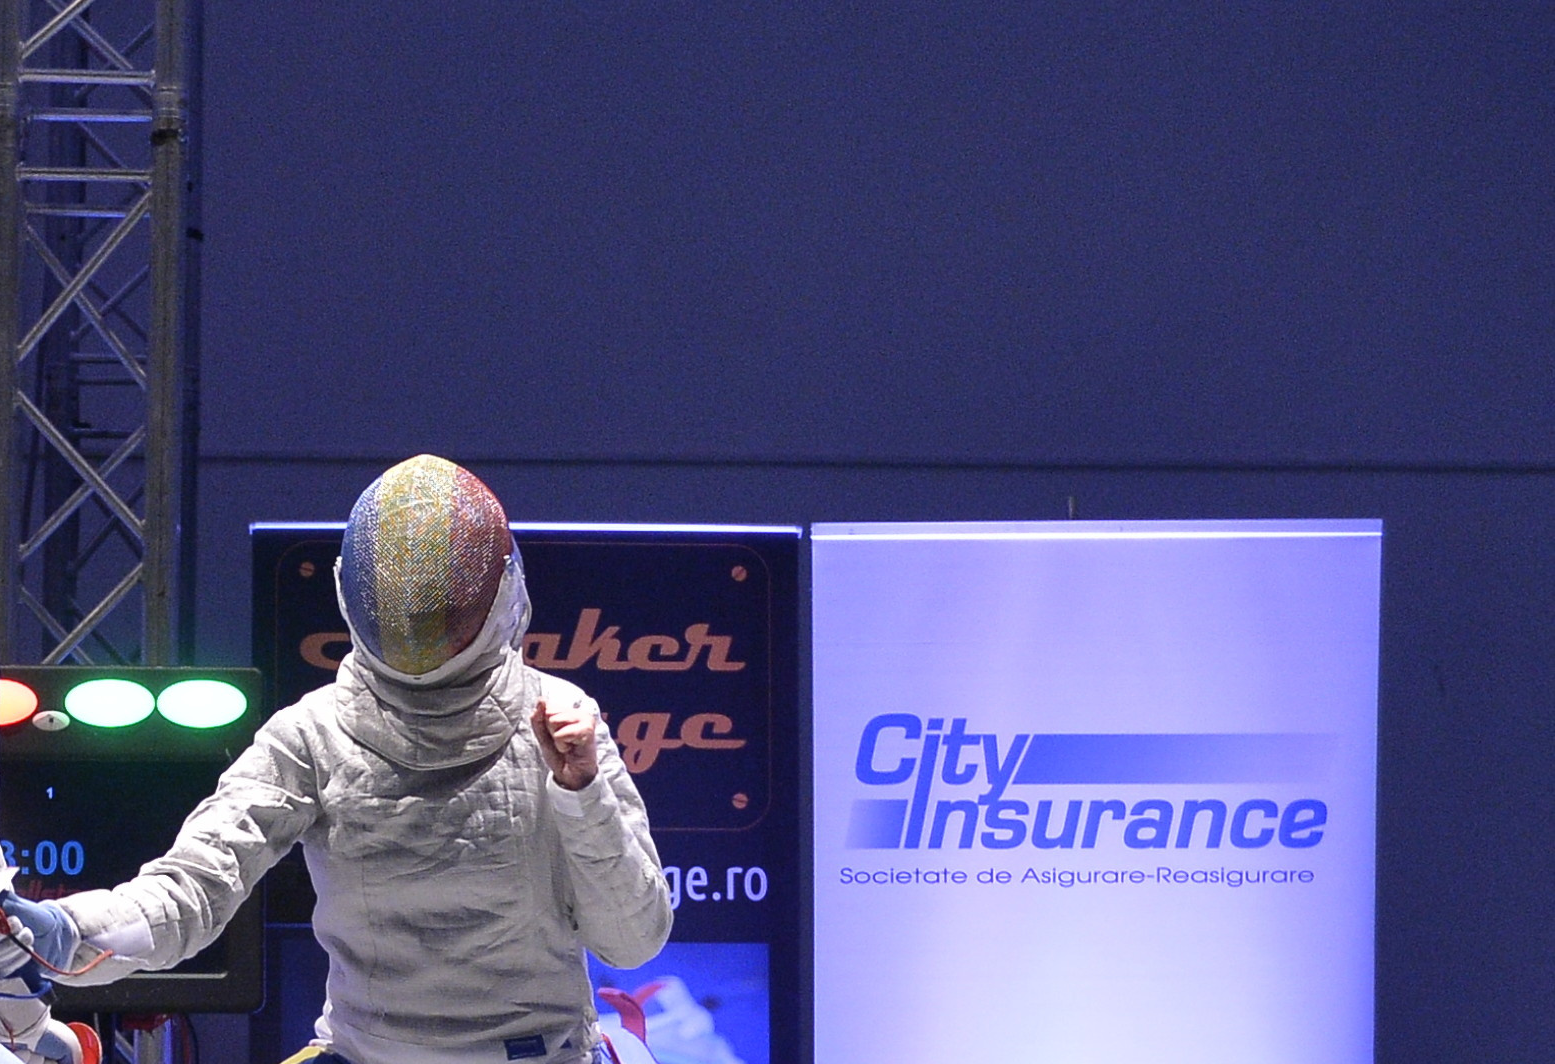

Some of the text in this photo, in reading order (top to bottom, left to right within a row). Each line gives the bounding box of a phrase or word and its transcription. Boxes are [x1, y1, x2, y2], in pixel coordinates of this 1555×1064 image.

[855, 713, 1031, 806] City
[839, 866, 1315, 889] Societate de Asigurare-Reasigurare
